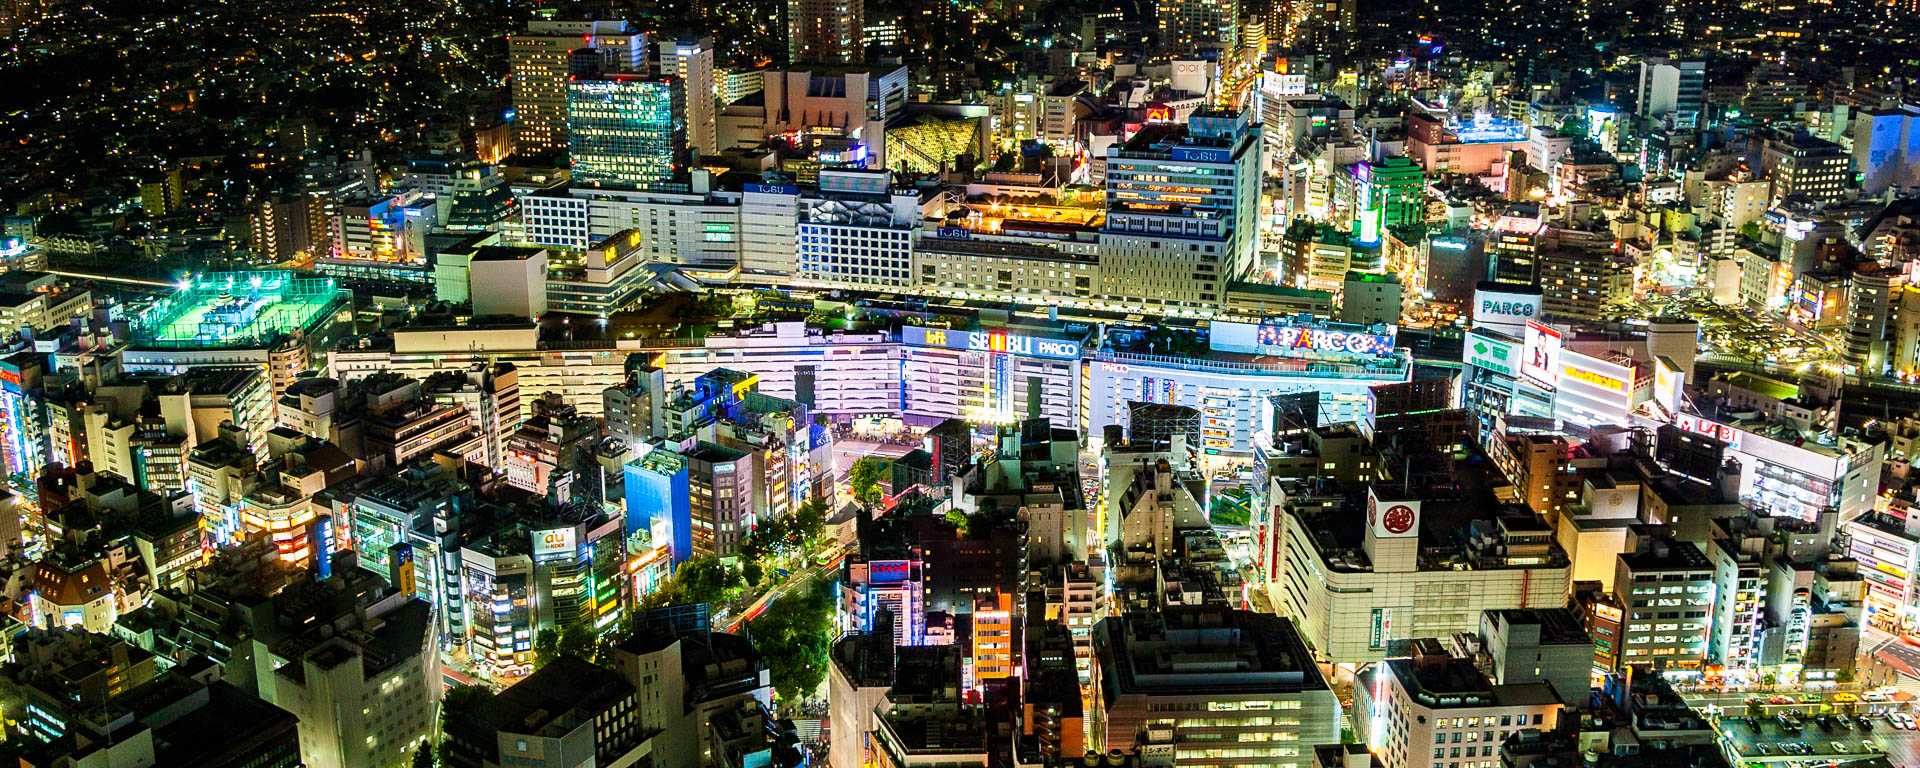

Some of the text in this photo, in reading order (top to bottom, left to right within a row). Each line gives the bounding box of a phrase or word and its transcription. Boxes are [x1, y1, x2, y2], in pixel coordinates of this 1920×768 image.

[1183, 150, 1217, 162] TOBU
[758, 184, 784, 194] TOBU
[938, 228, 968, 238] TOBU
[1482, 299, 1534, 318] PARCO
[968, 331, 1032, 355] SEIBU
[1283, 327, 1366, 353] PARCO
[1038, 341, 1078, 357] PARCO
[1101, 361, 1129, 374] PARCO
[545, 532, 565, 544] au
